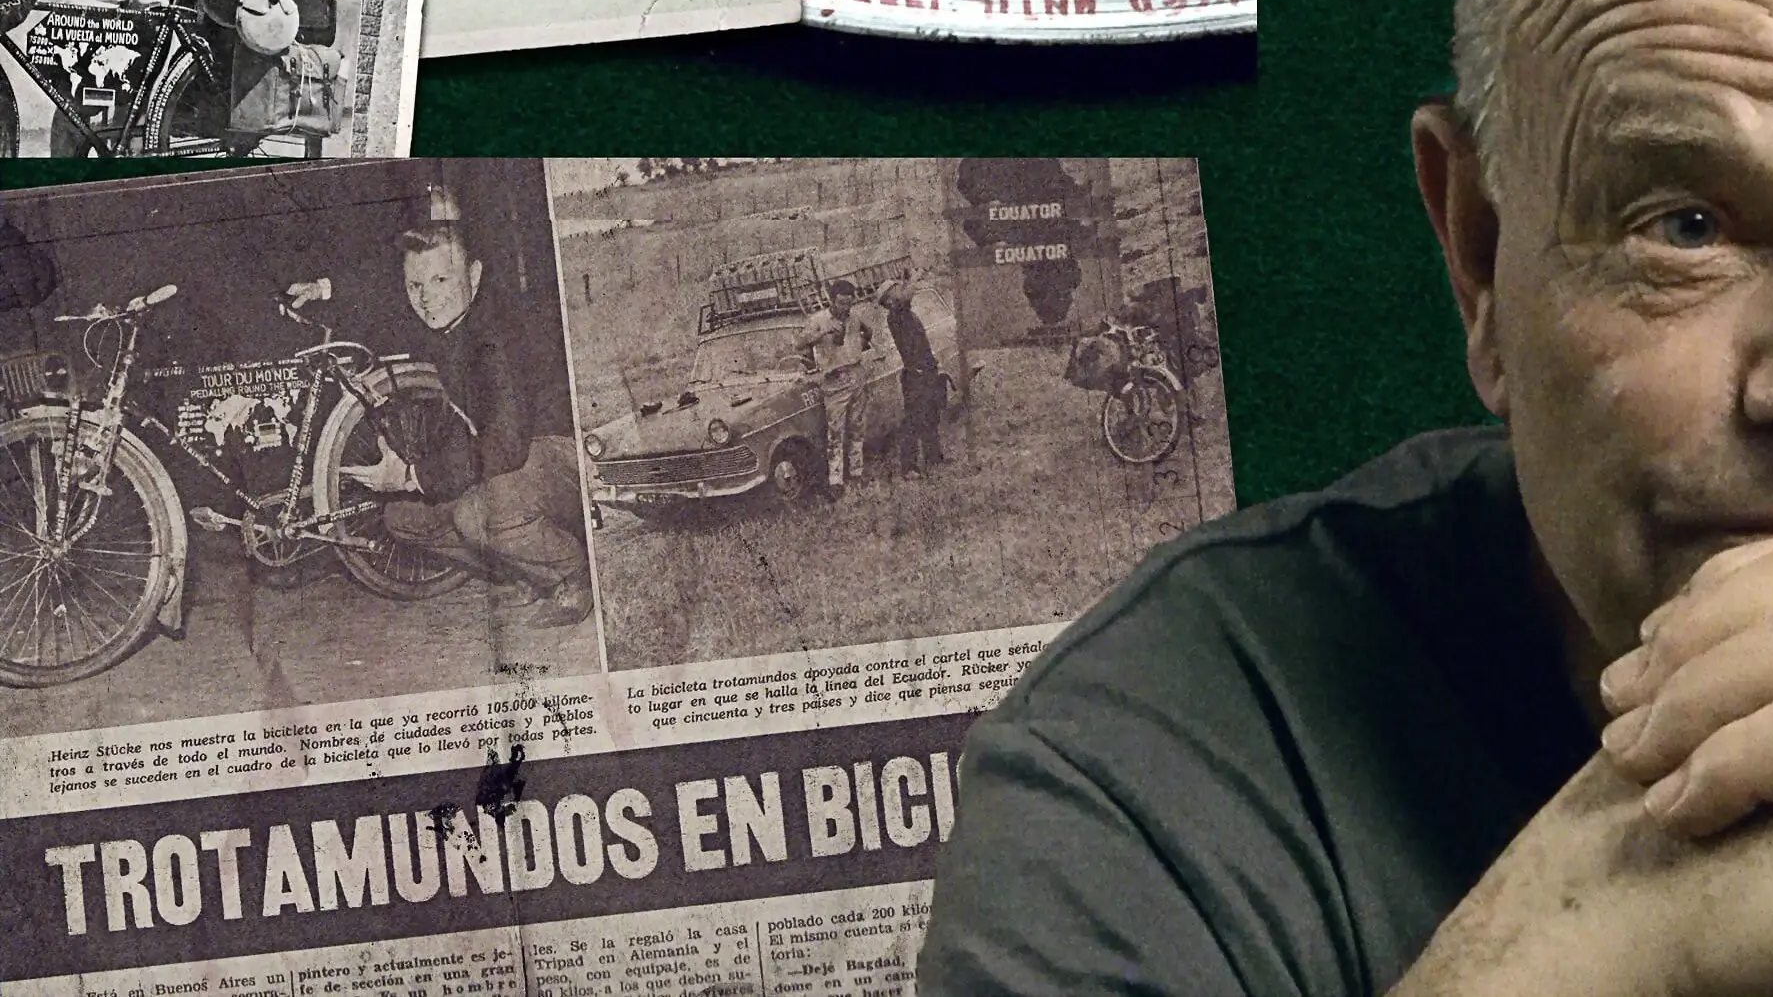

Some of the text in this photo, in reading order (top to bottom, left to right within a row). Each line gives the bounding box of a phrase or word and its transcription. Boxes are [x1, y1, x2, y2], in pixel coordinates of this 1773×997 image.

[47, 13, 85, 27] AROUND
[102, 18, 133, 31] WORLD
[50, 27, 138, 45] LA VUELTA MUNDO
[989, 202, 1062, 221] EQUATOR
[995, 244, 1068, 263] EQUATOR
[201, 367, 299, 388] TOUR DU MONDE
[651, 648, 1002, 696] bicicleta trotamundos apoyada contra cartel que
[648, 668, 951, 714] lugar que halla Ecuador.
[683, 682, 972, 724] cincuenta tres dice que piensa
[51, 704, 479, 762] Heinz Stücke muestra bicicleta que recorrió
[102, 708, 594, 772] través todo mundo. Nombres ciudades exóticas pueblos
[49, 748, 380, 795] lejanos suceden cuadro bicicleta
[45, 752, 960, 936] TROTAMUNDOS EN BICI
[767, 910, 865, 933] poblado cada
[627, 923, 747, 948] regaló casa
[297, 952, 464, 981] pintero actualmente
[534, 942, 699, 972] Tripad Alemania
[217, 974, 256, 989] Aires
[350, 973, 404, 990] sección
